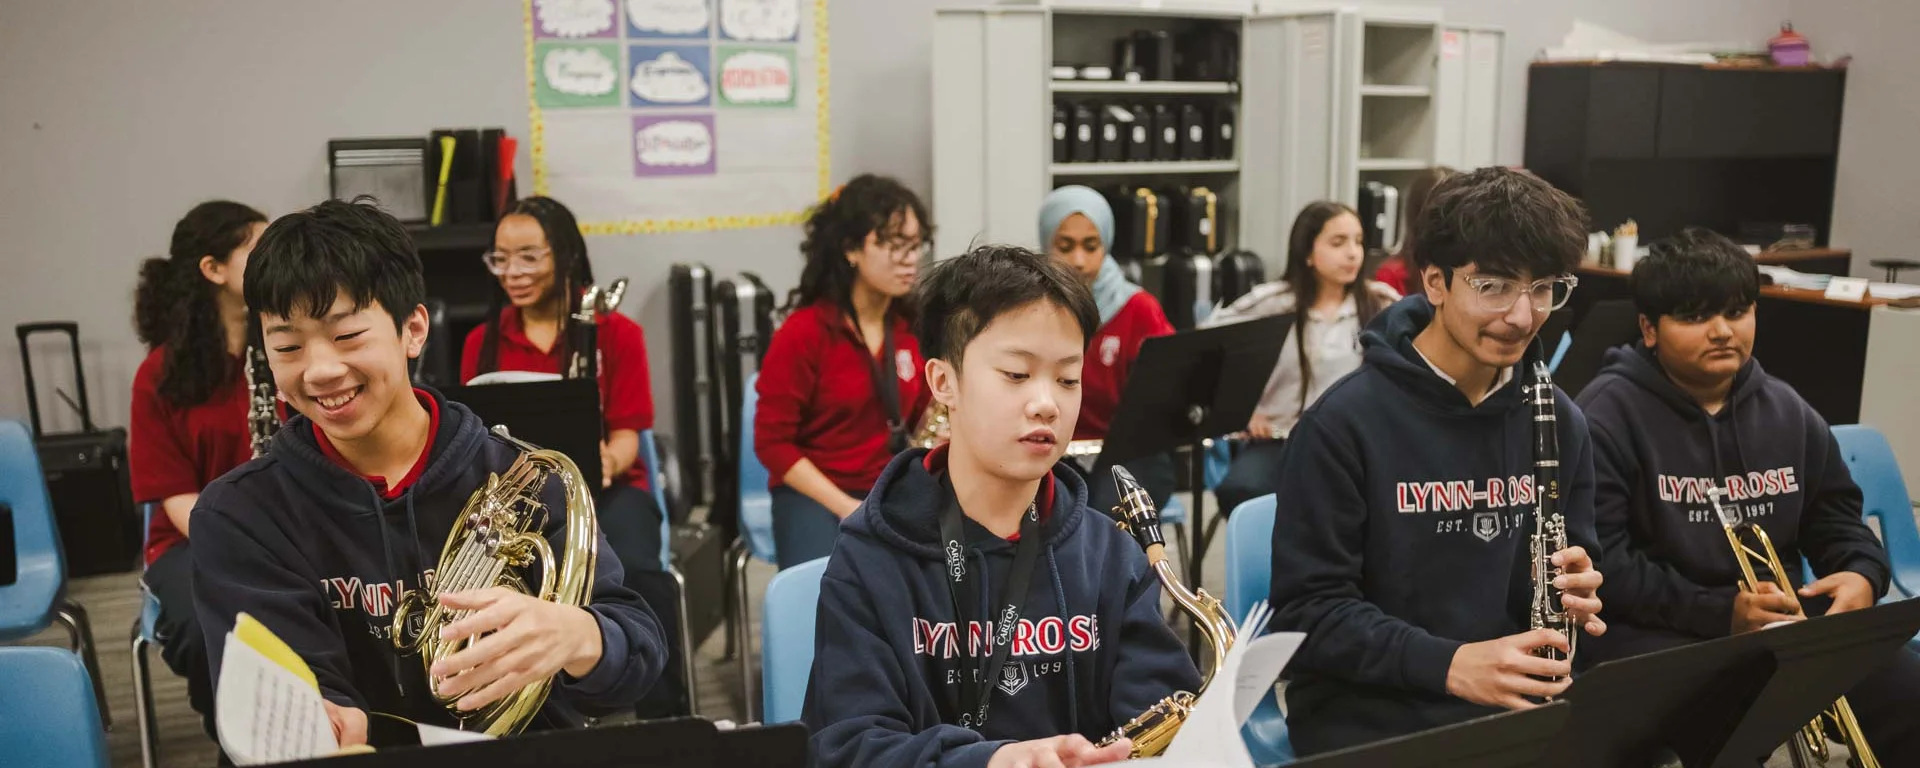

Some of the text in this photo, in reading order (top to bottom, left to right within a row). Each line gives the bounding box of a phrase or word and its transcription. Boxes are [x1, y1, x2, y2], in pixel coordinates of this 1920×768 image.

[1746, 502, 1774, 518] 1997
[1436, 519, 1468, 533] EST.
[949, 540, 962, 582] CARLTON
[997, 604, 1017, 646] CARLTON
[1034, 661, 1062, 678] 199
